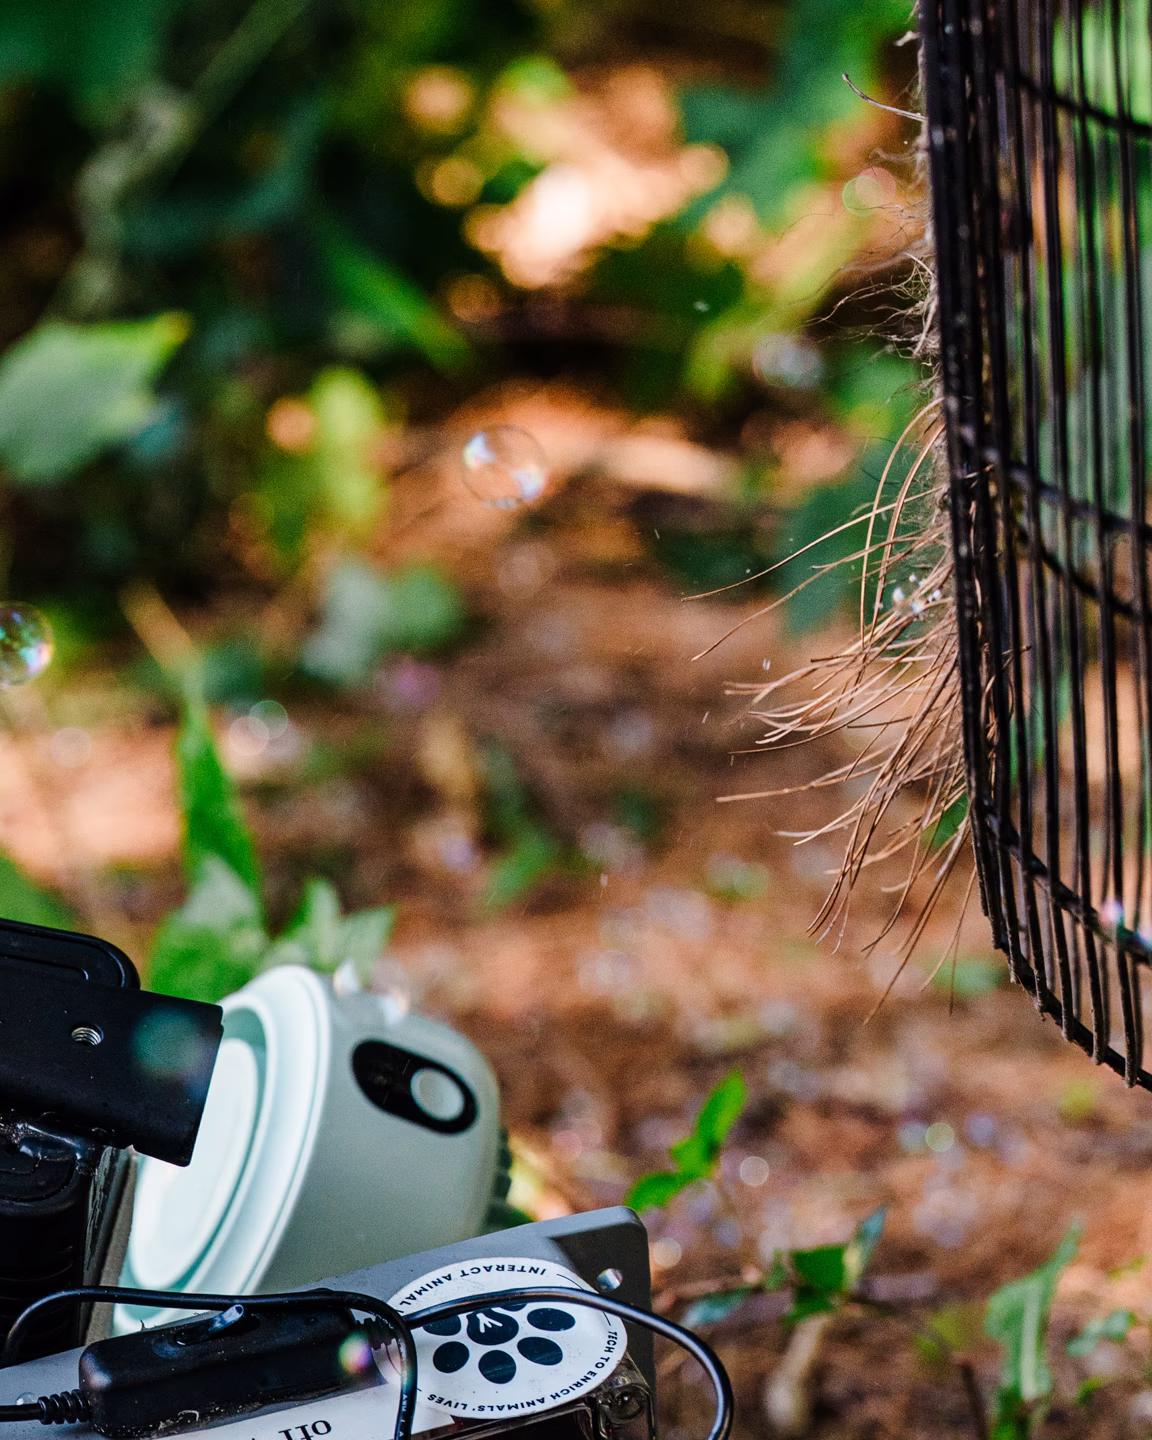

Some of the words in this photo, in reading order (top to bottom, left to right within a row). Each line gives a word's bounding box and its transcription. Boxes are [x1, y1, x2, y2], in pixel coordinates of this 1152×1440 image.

[460, 1264, 546, 1278] INTERACT
[399, 1274, 452, 1306] ANIMAL
[605, 1330, 618, 1354] TECH
[595, 1355, 610, 1370] TO
[550, 1370, 597, 1401] ENRICH
[427, 1393, 467, 1411] LIVES
